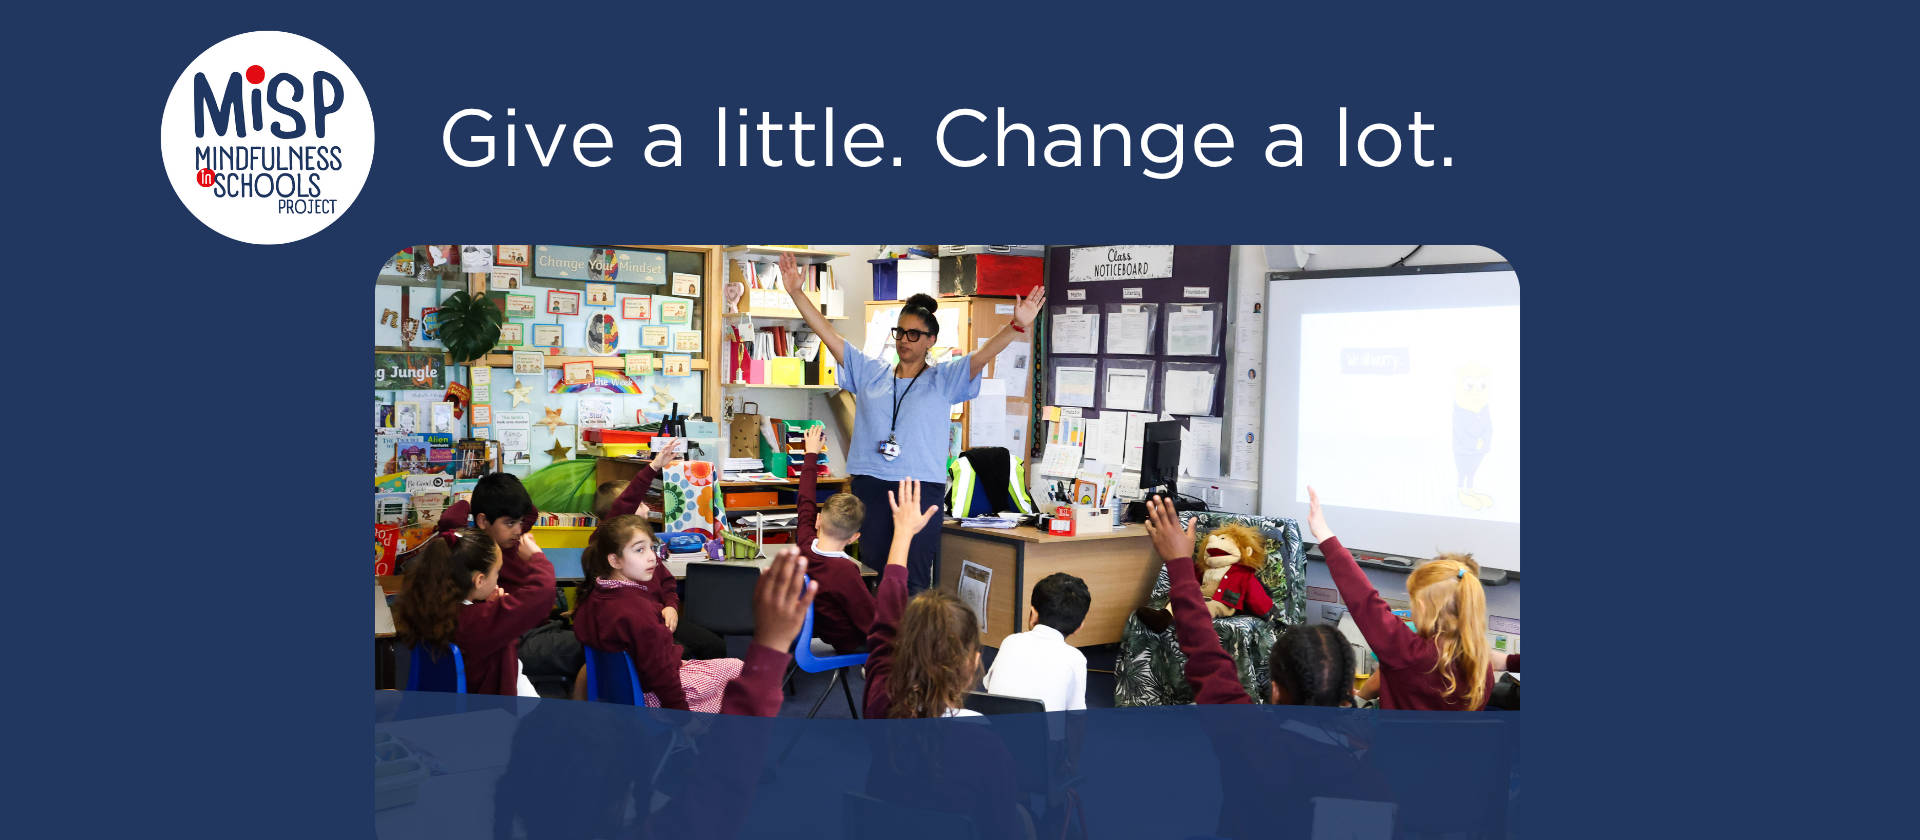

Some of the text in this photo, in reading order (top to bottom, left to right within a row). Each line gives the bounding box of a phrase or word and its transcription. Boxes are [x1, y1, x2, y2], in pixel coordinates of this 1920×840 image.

[1107, 248, 1132, 263] Class
[539, 255, 663, 274] Change Your Mindset
[1094, 262, 1149, 277] NOTICEBOARD
[390, 365, 438, 382] Jungle
[594, 378, 608, 386] the
[428, 435, 449, 443] Alien
